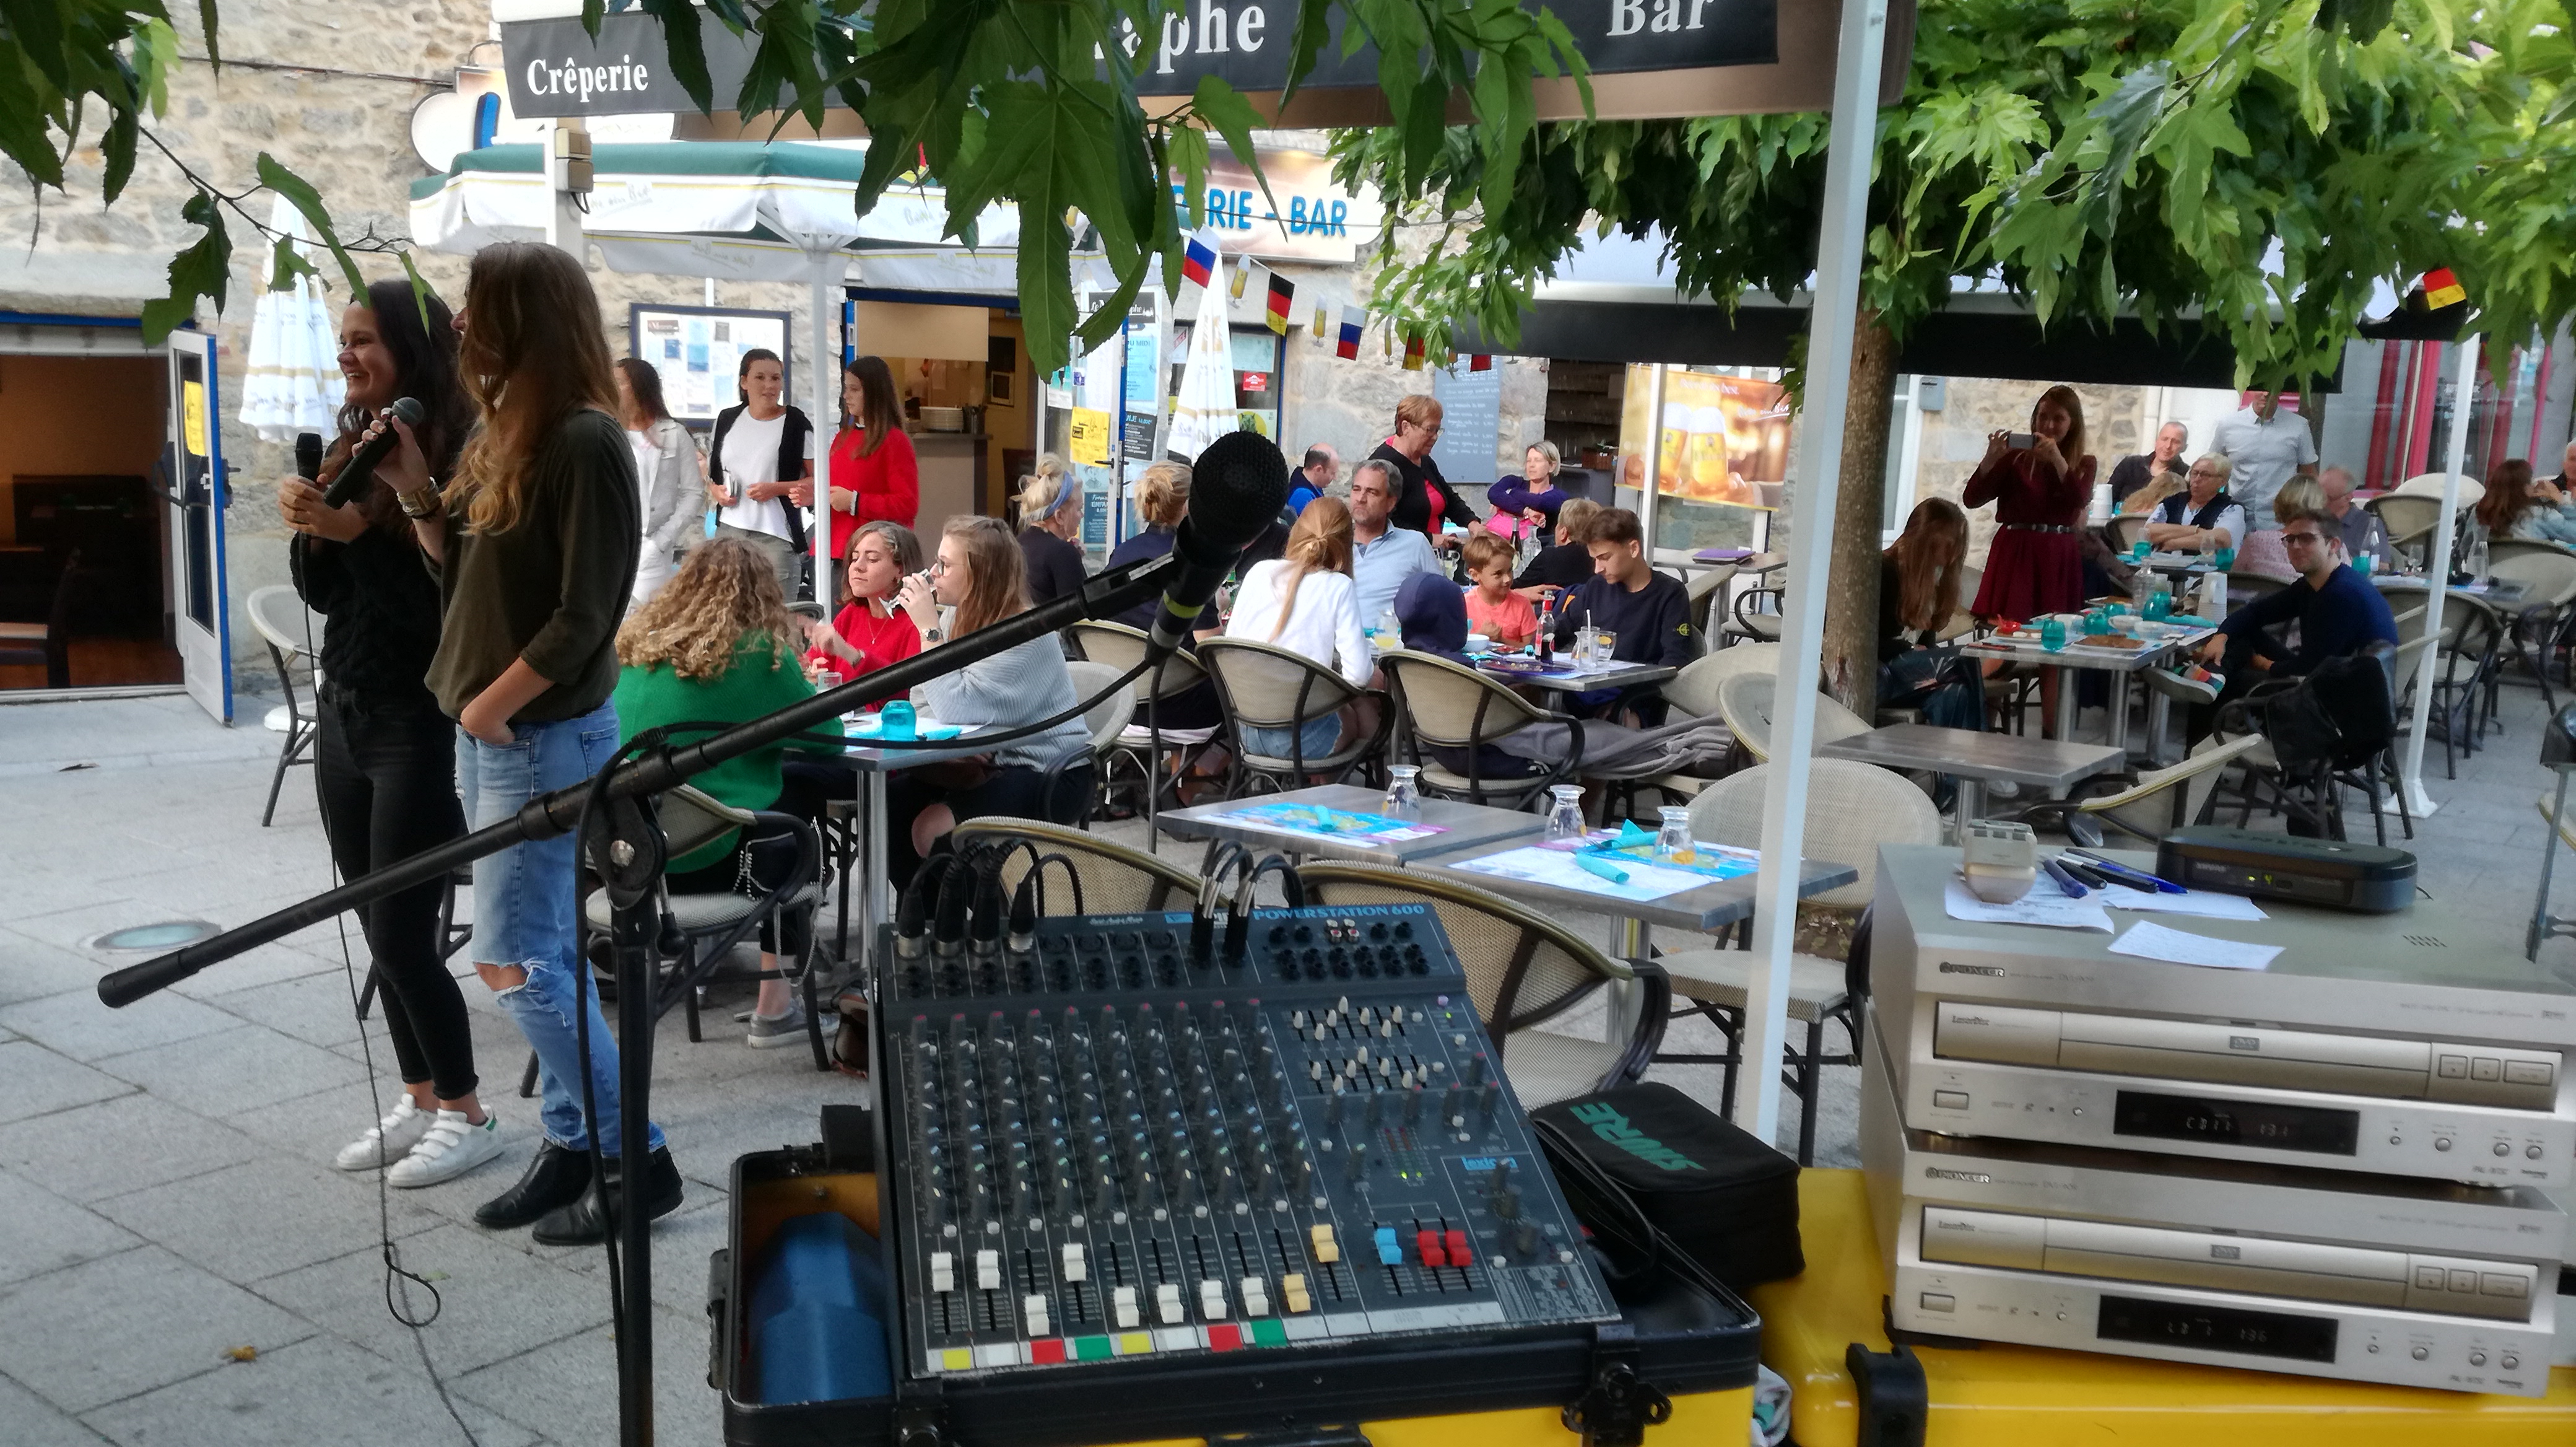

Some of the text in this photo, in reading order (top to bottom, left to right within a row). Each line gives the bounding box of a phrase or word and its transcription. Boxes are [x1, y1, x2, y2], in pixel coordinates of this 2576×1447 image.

[1606, 0, 1714, 36] Bar
[527, 54, 648, 102] Crêperie
[1290, 196, 1348, 237] BAR
[1252, 904, 1425, 921] POWERSTATION 600
[1569, 1101, 1707, 1171] SHURE
